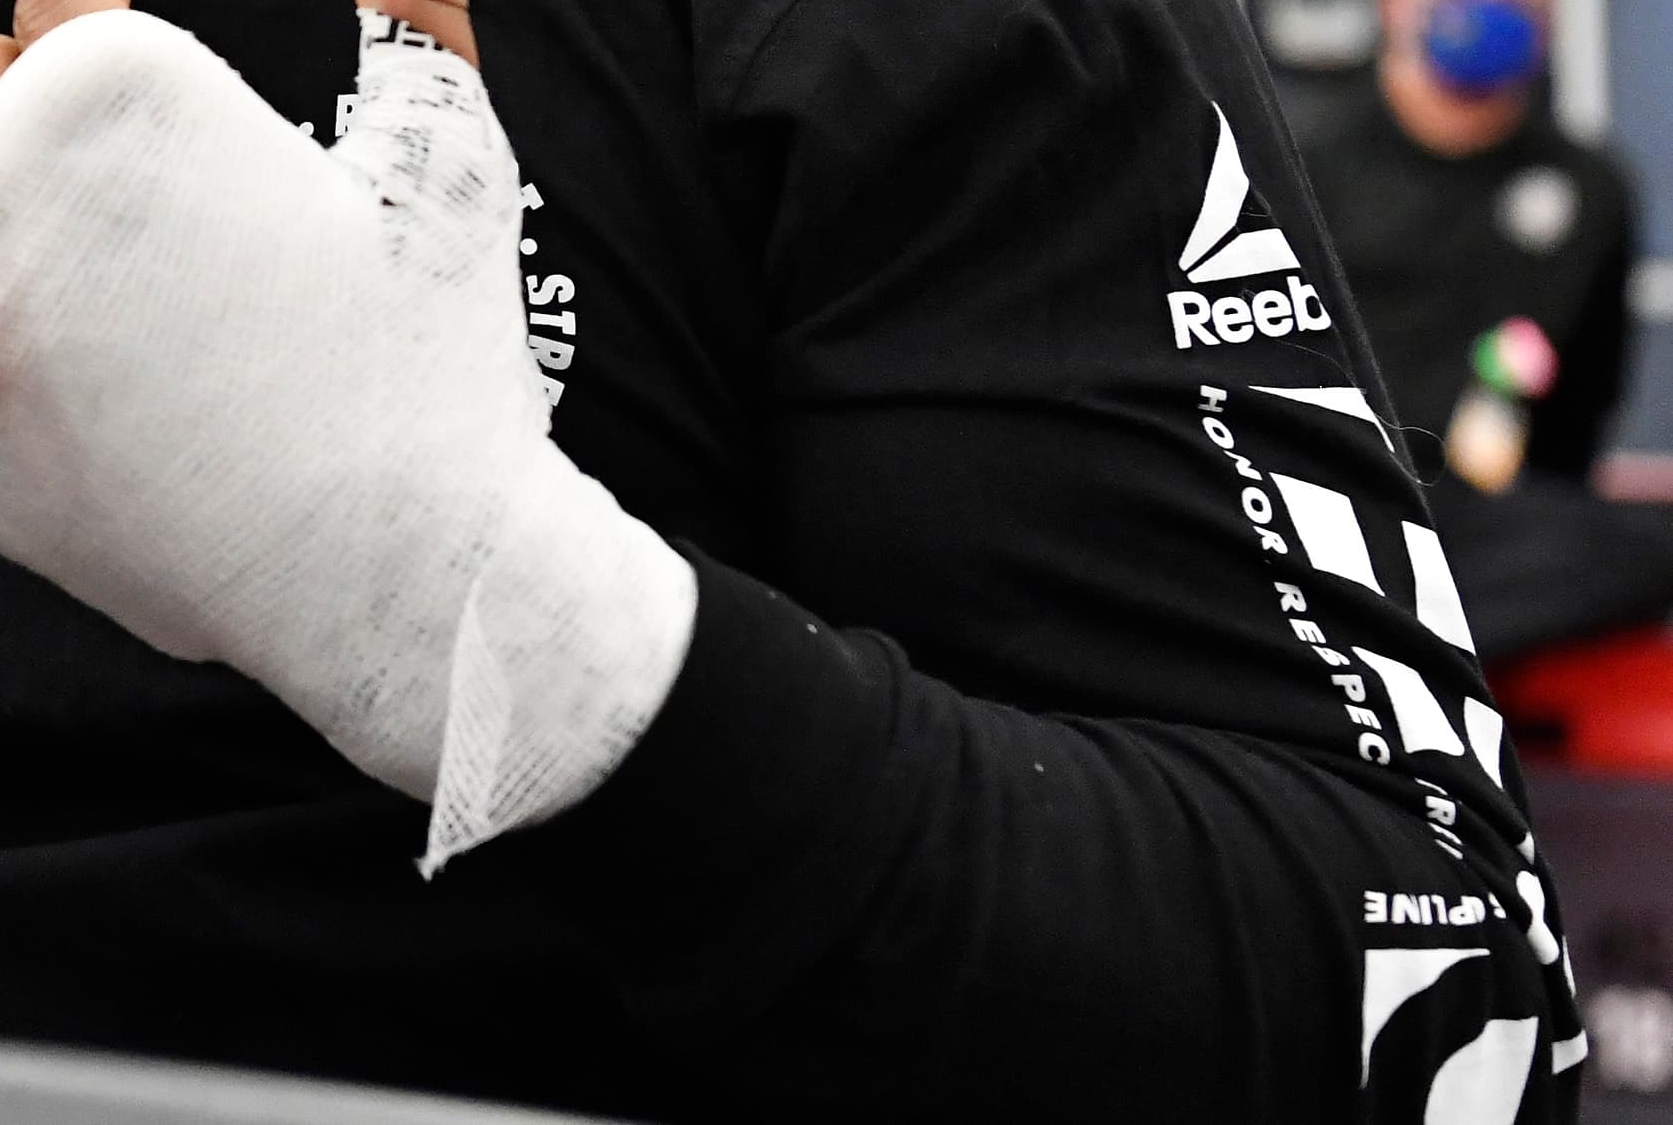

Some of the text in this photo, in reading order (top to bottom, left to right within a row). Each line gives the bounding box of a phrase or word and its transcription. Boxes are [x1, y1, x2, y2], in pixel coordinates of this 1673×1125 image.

[1166, 275, 1333, 349] Reeb
[1199, 385, 1391, 767] HONOR RESPEC
